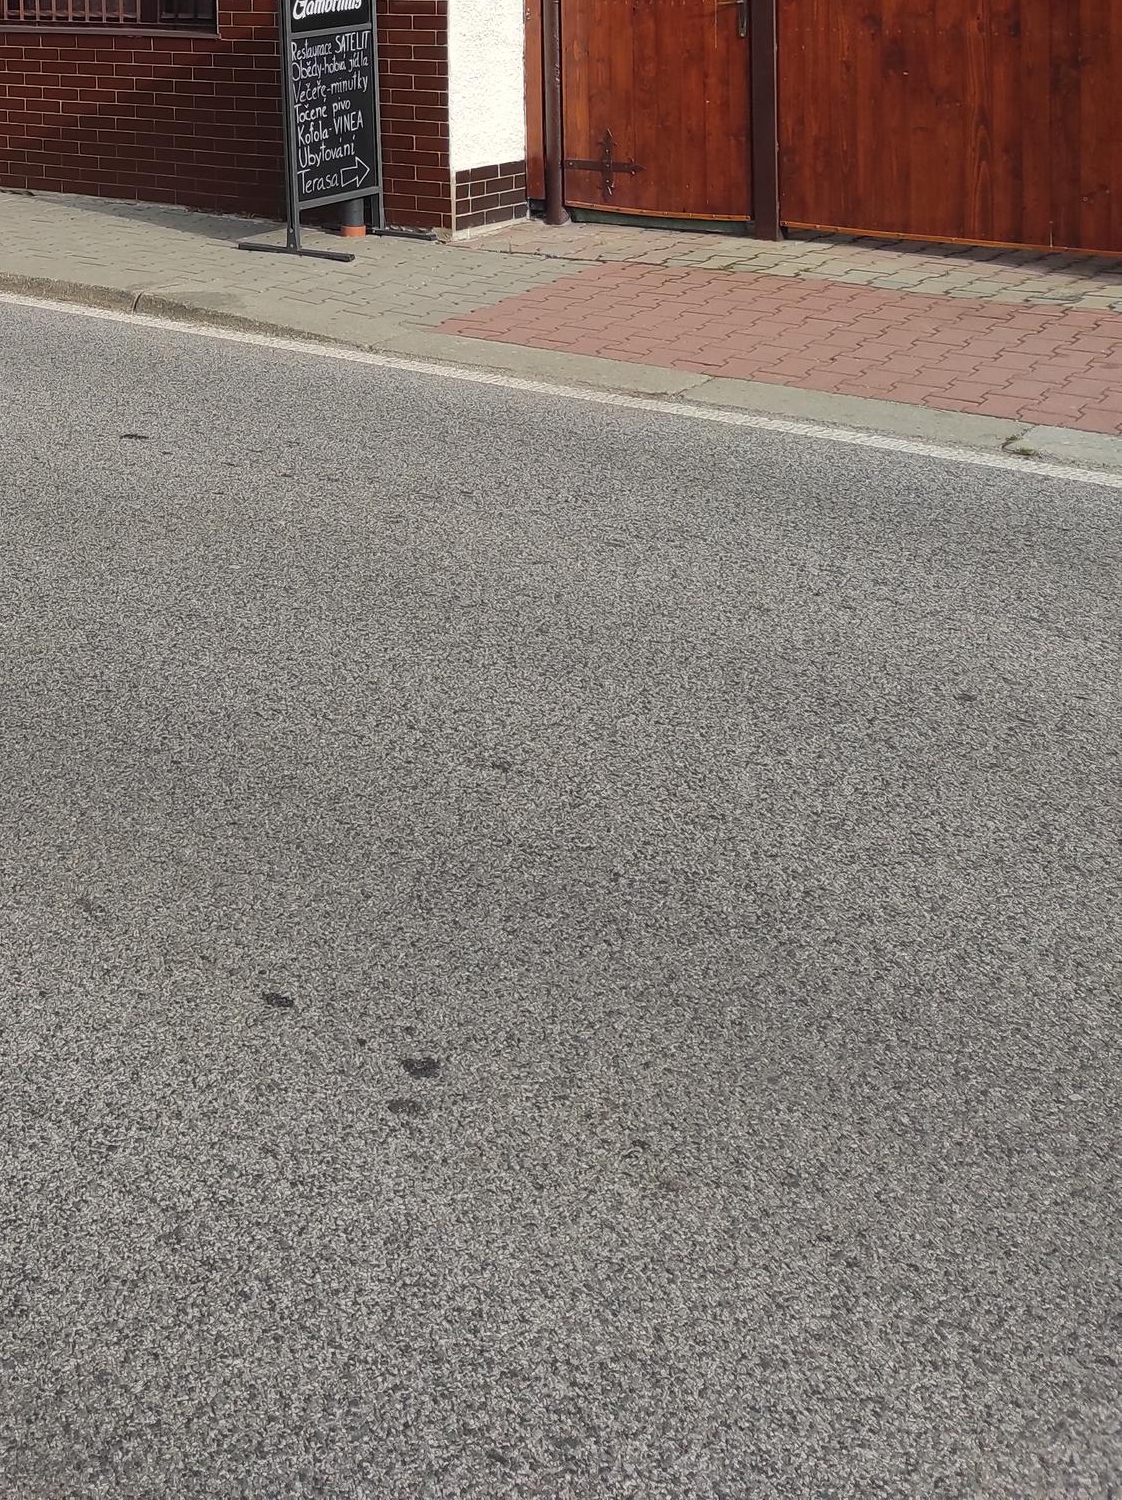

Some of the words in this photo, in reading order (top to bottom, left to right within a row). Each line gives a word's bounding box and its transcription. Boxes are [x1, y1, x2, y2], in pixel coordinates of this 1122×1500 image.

[291, 39, 332, 61] Restaurace
[335, 31, 371, 53] SATELIT
[348, 51, 369, 72] jídla
[294, 98, 327, 123] Točené
[332, 97, 351, 118] pivo
[298, 134, 355, 168] Ubytování
[297, 169, 339, 194] Terasa
